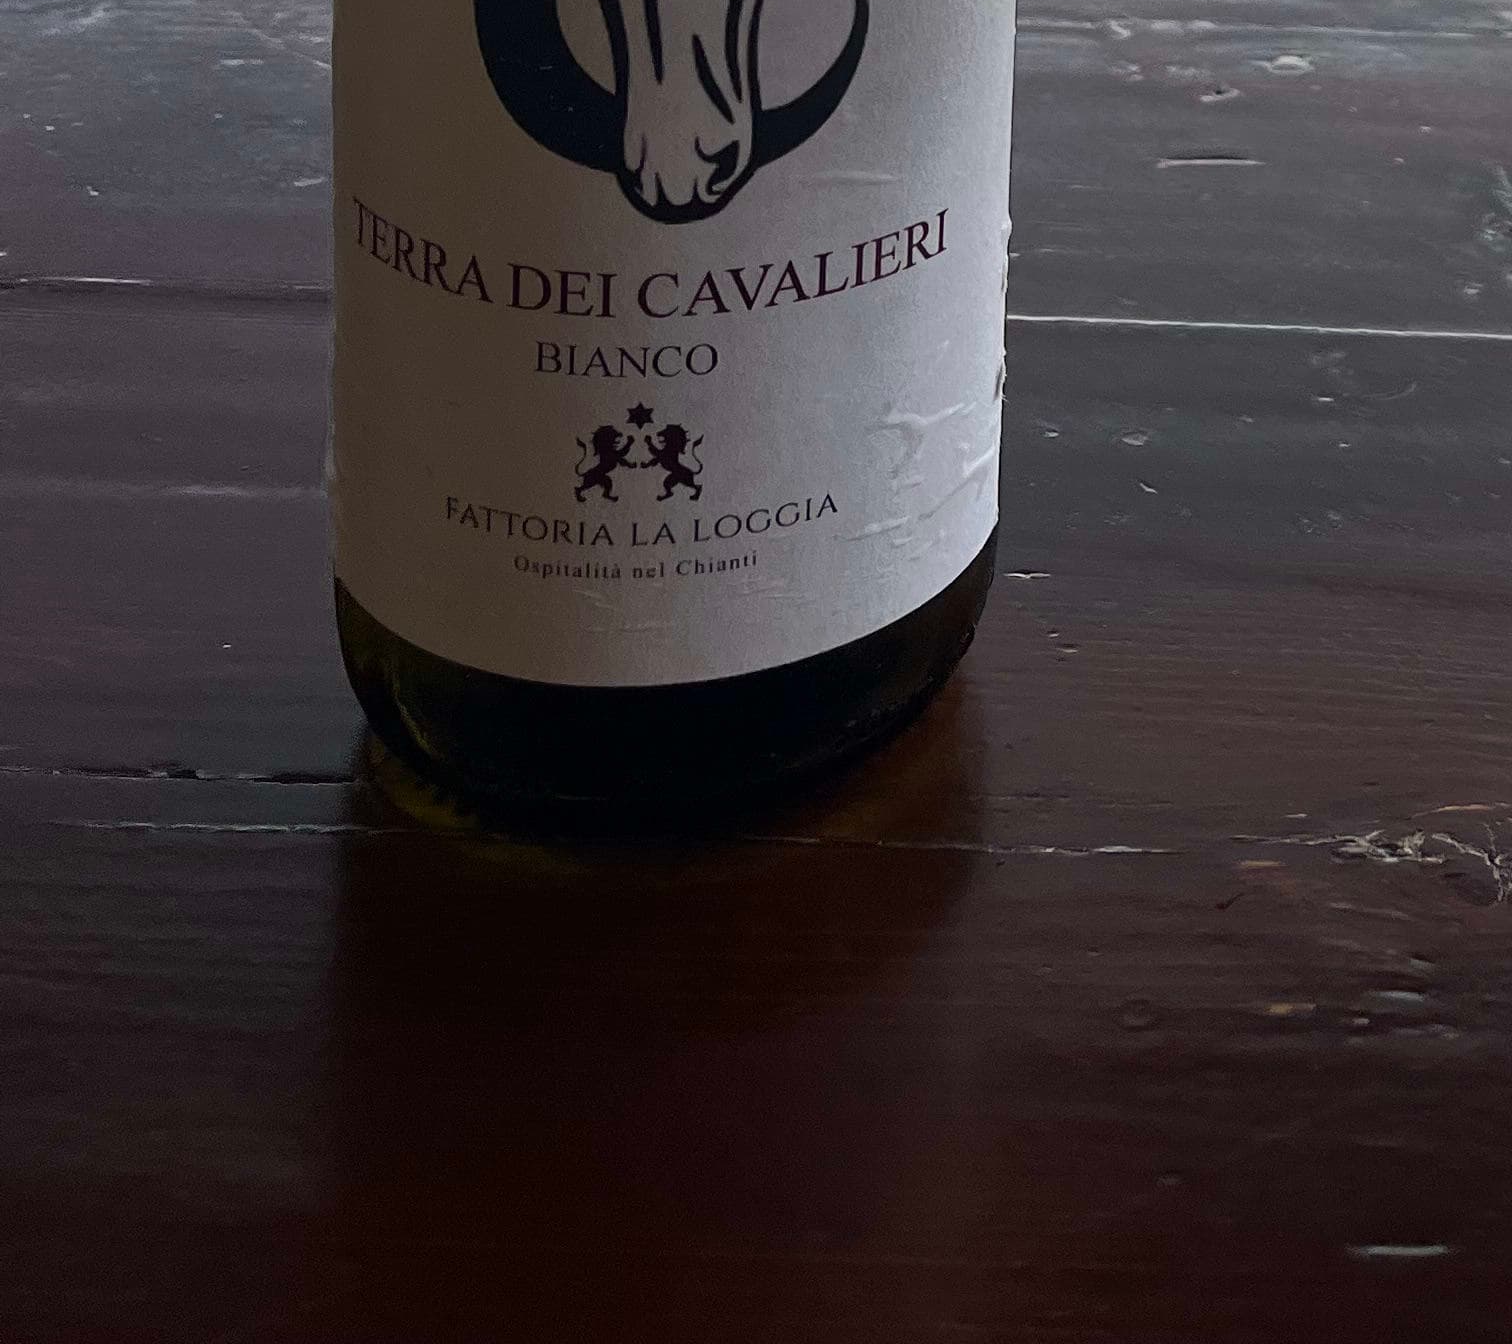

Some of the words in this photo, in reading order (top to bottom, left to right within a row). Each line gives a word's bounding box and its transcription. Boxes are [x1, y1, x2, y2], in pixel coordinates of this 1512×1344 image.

[353, 196, 494, 305] TERRA
[506, 262, 616, 319] DEI
[637, 208, 949, 319] CAVALIERI
[534, 341, 720, 378] BIANCO
[444, 495, 615, 547] FATTORIA
[631, 521, 677, 547] LA
[694, 492, 838, 544] LOGGIA
[513, 554, 621, 581] Ospitalità
[632, 558, 666, 578] nel
[676, 548, 758, 577] Chianti
